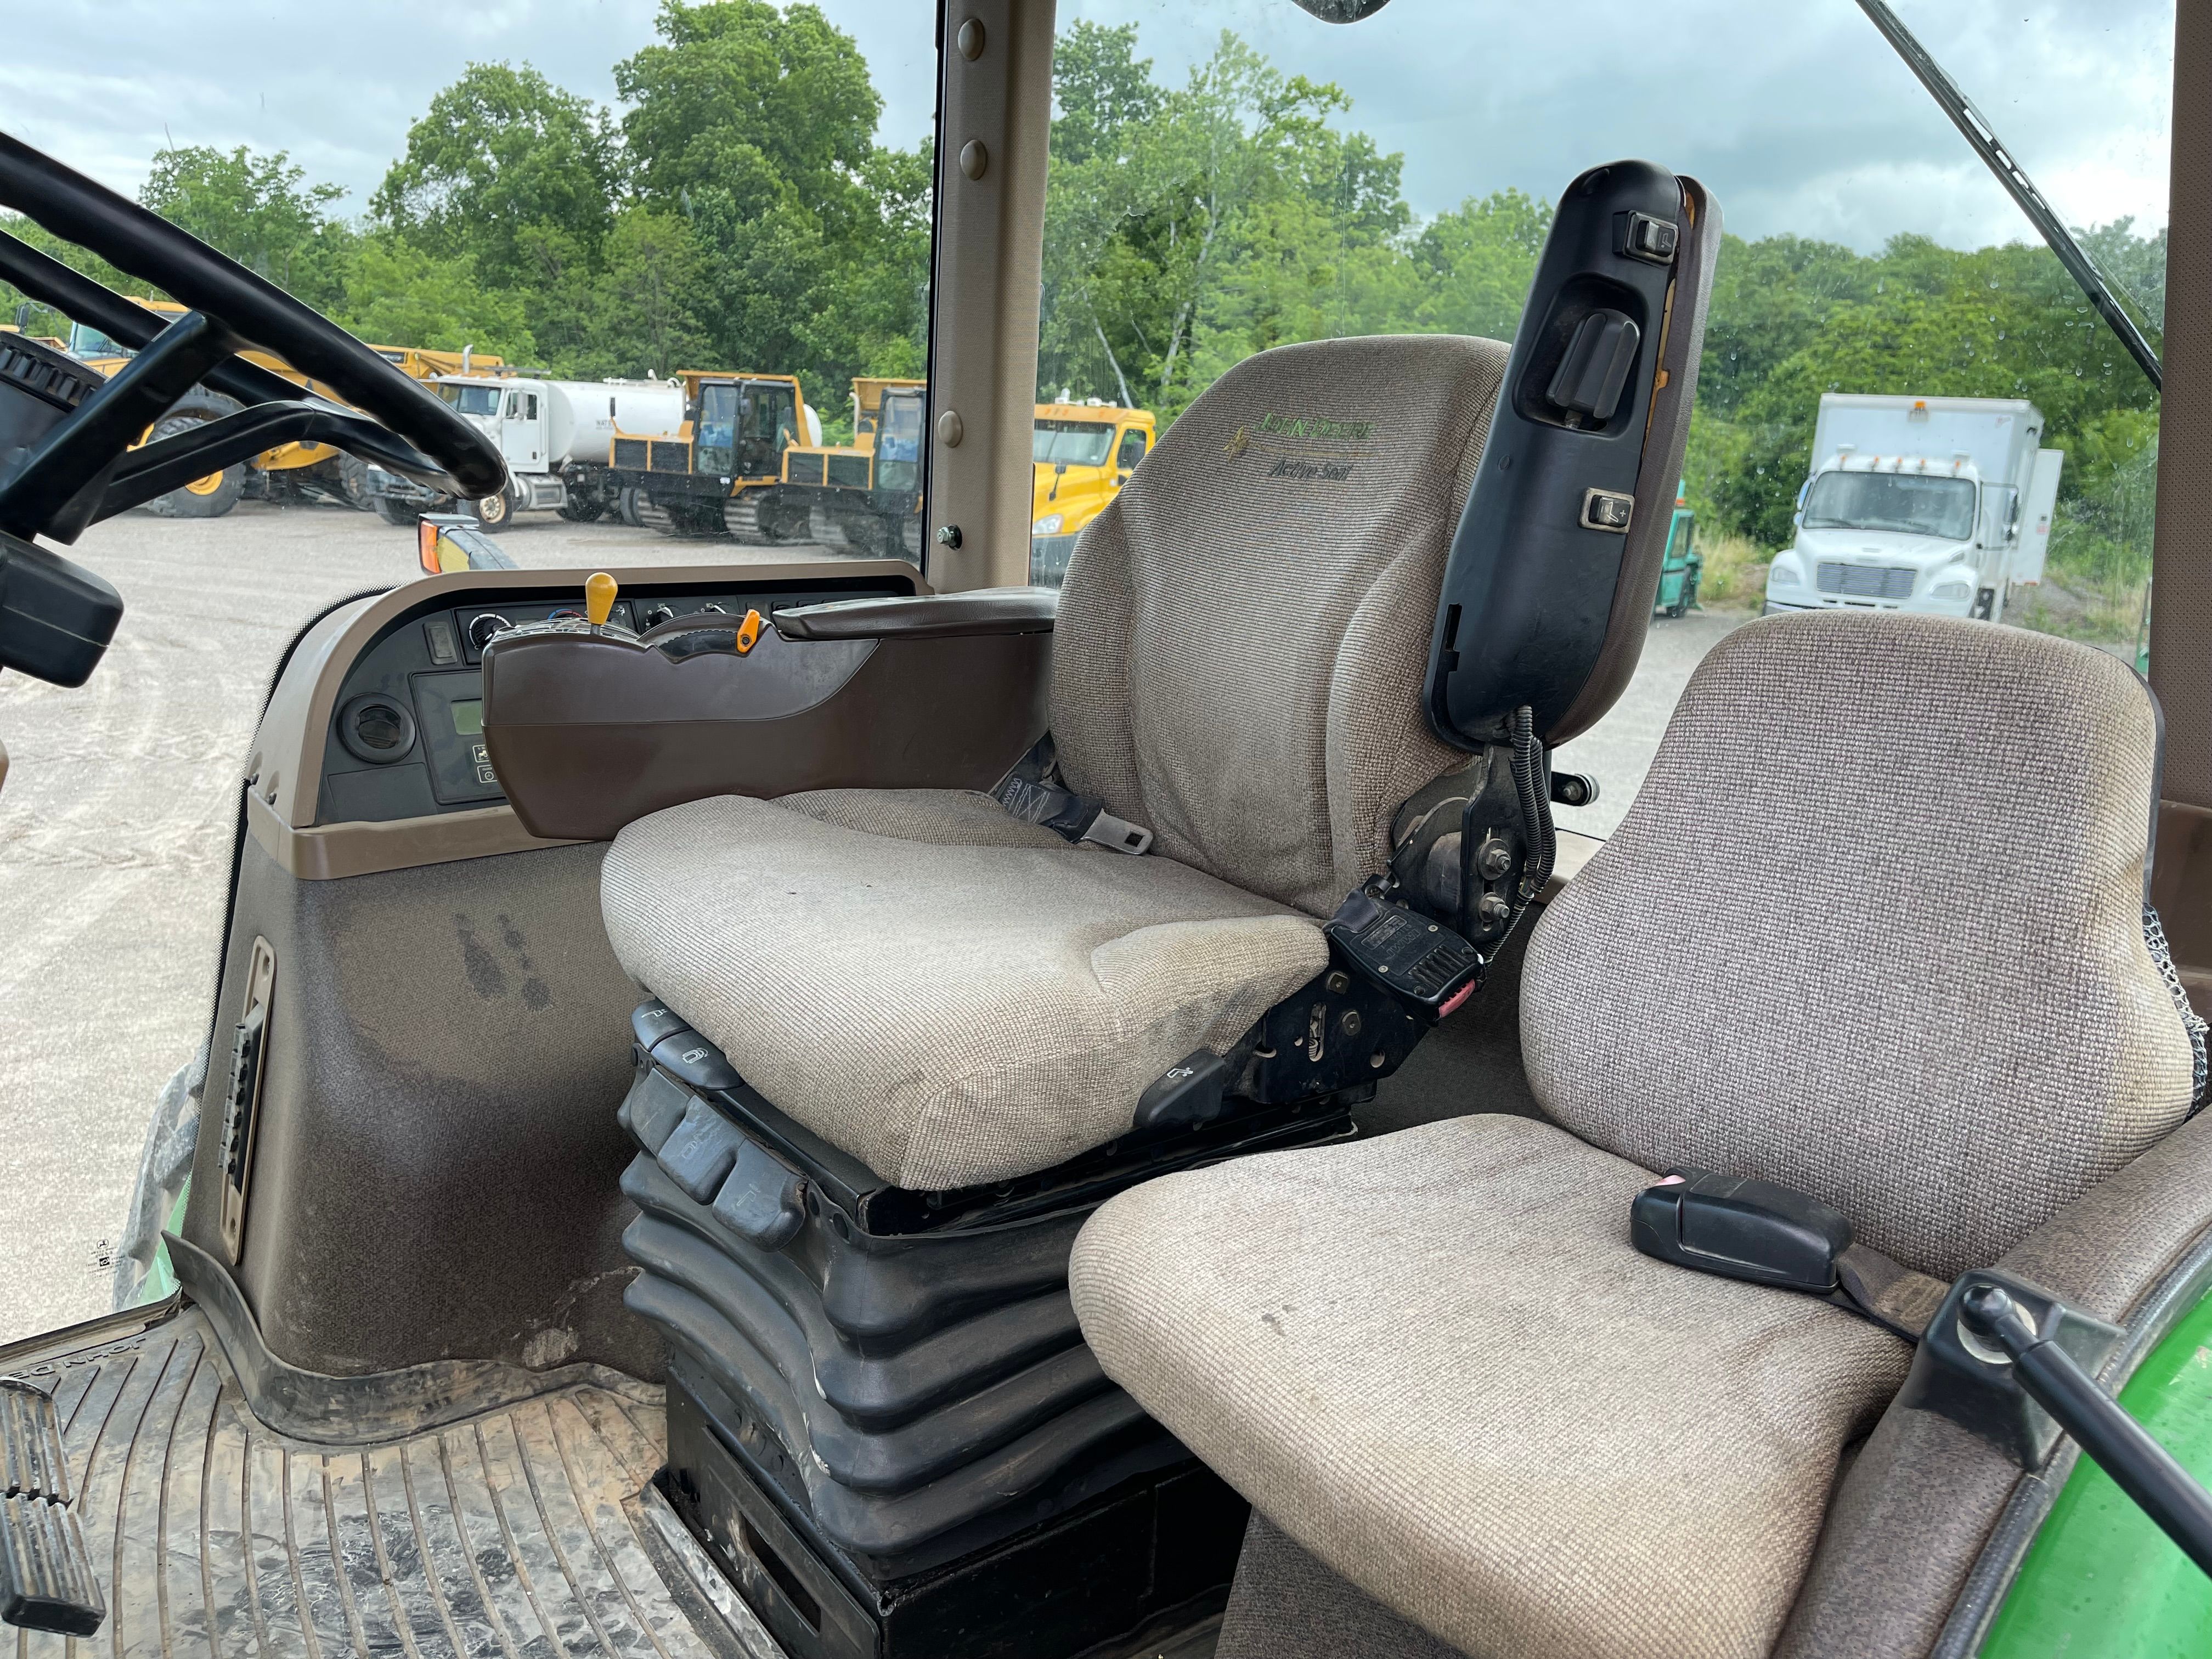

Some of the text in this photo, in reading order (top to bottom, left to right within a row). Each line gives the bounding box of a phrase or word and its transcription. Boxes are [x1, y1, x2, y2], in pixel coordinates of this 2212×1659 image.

[1267, 459, 1353, 481] Active Seat
[64, 1338, 146, 1368] JOHN
